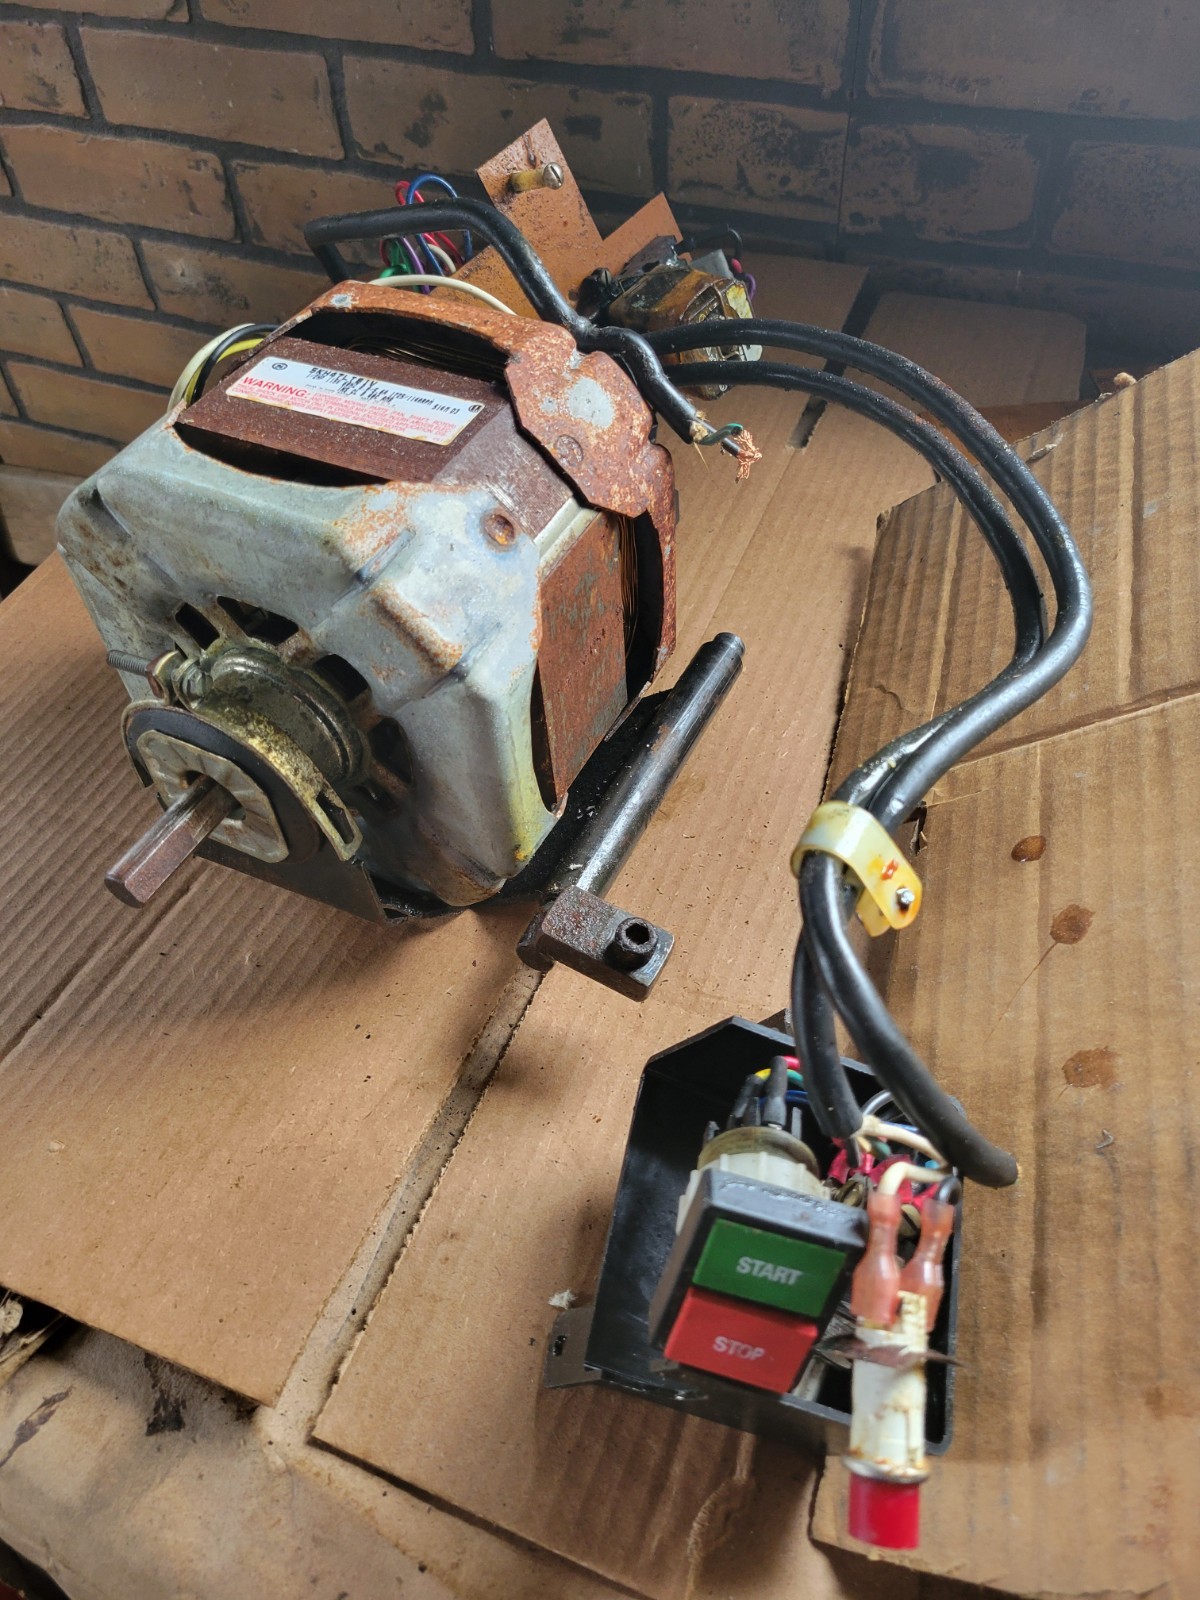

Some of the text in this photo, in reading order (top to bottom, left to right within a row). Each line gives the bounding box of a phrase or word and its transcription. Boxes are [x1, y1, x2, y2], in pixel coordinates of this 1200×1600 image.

[242, 376, 311, 399] WARNING:
[736, 1256, 803, 1286] START
[712, 1336, 765, 1361] STOP
